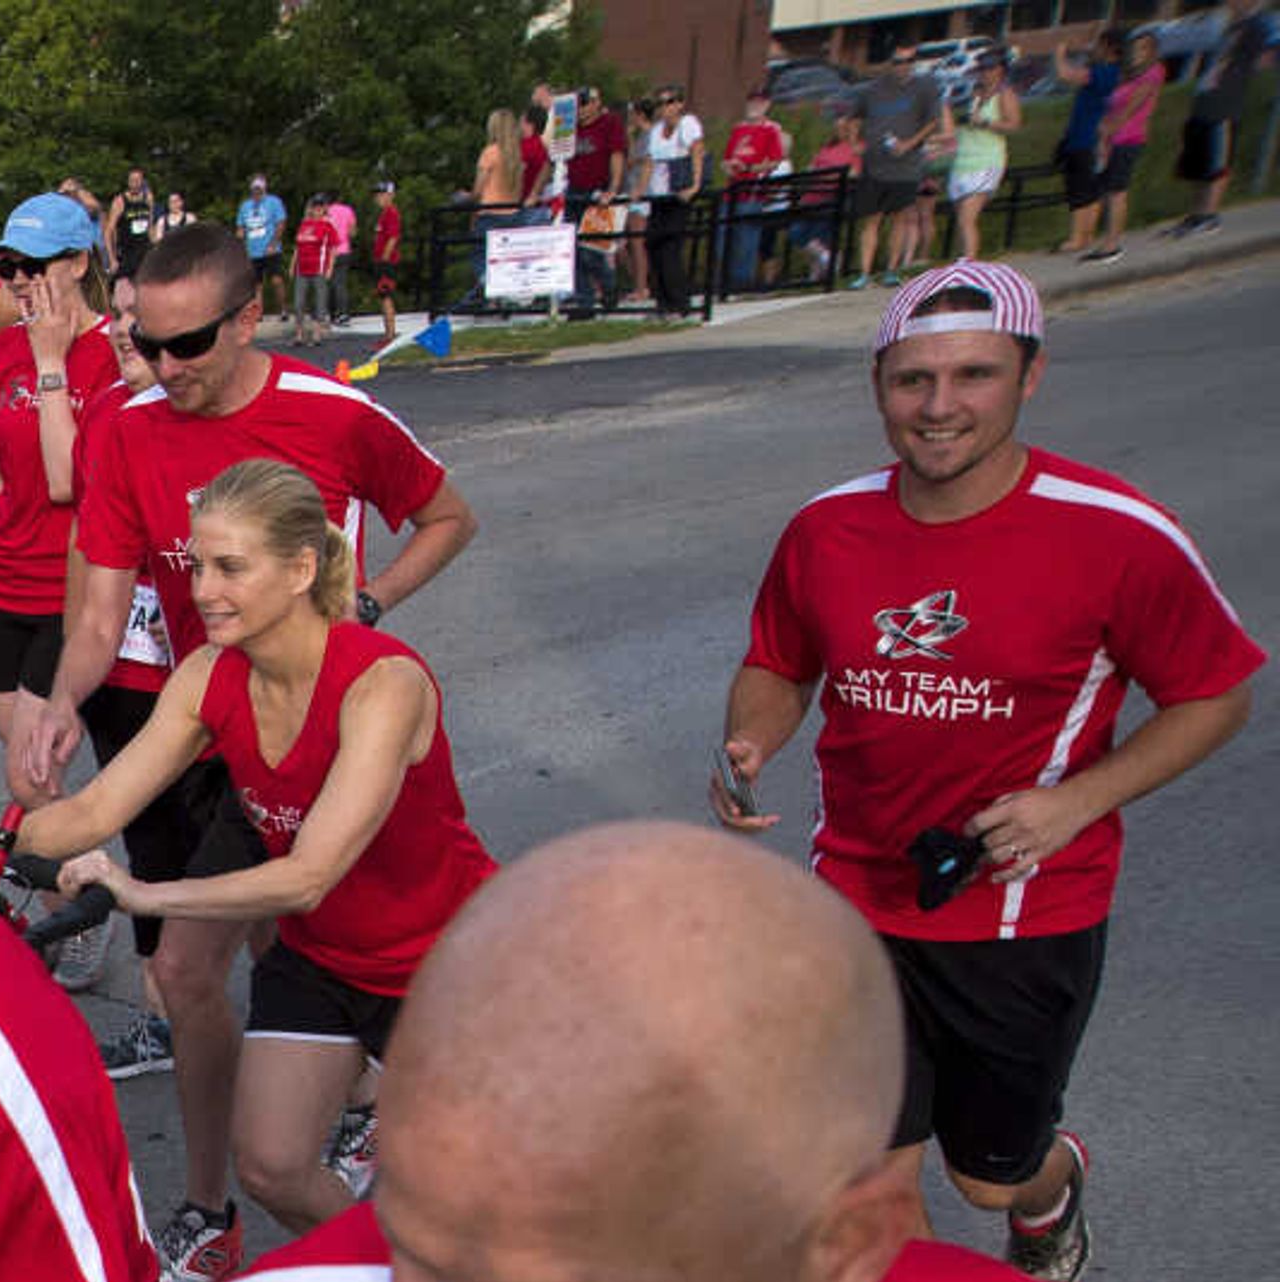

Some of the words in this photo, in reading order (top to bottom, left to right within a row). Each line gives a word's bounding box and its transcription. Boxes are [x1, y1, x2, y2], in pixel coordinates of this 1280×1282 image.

[843, 667, 892, 688] MY
[899, 671, 991, 696] TEAM
[834, 682, 1015, 722] TRIUMPH
